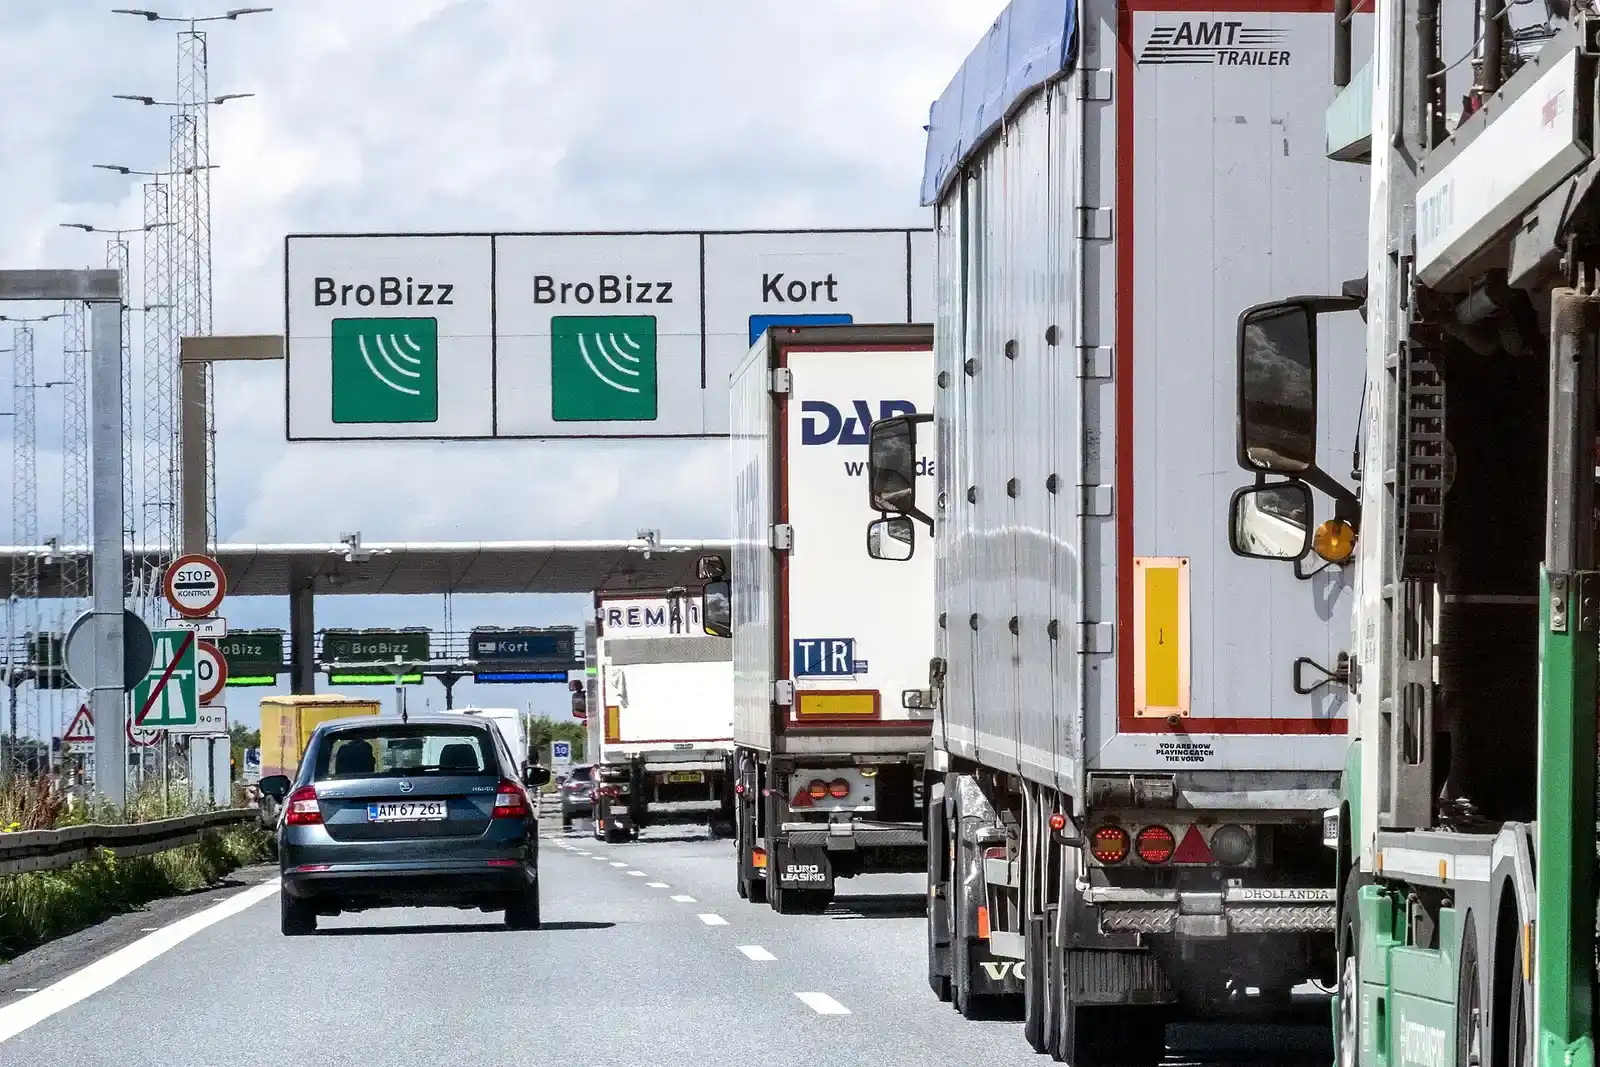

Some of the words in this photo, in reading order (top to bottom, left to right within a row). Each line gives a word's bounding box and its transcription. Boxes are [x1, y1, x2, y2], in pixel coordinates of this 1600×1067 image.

[1174, 22, 1242, 46] AMT
[1217, 51, 1291, 66] TRAILER
[314, 277, 454, 306] BroBizz
[533, 275, 674, 305] BroBizz
[761, 273, 839, 303] Kort
[178, 571, 211, 581] STOP
[178, 589, 212, 597] KONTROL
[608, 607, 682, 626] REMA
[351, 642, 409, 655] BroBizz
[498, 640, 529, 652] Kort
[798, 641, 848, 672] TIR
[378, 803, 397, 817] AM
[399, 803, 415, 816] 67
[418, 803, 443, 816] 261
[787, 864, 819, 873] EURO
[780, 873, 825, 881] LEASING
[1243, 889, 1330, 900] DHOLLANDIA
